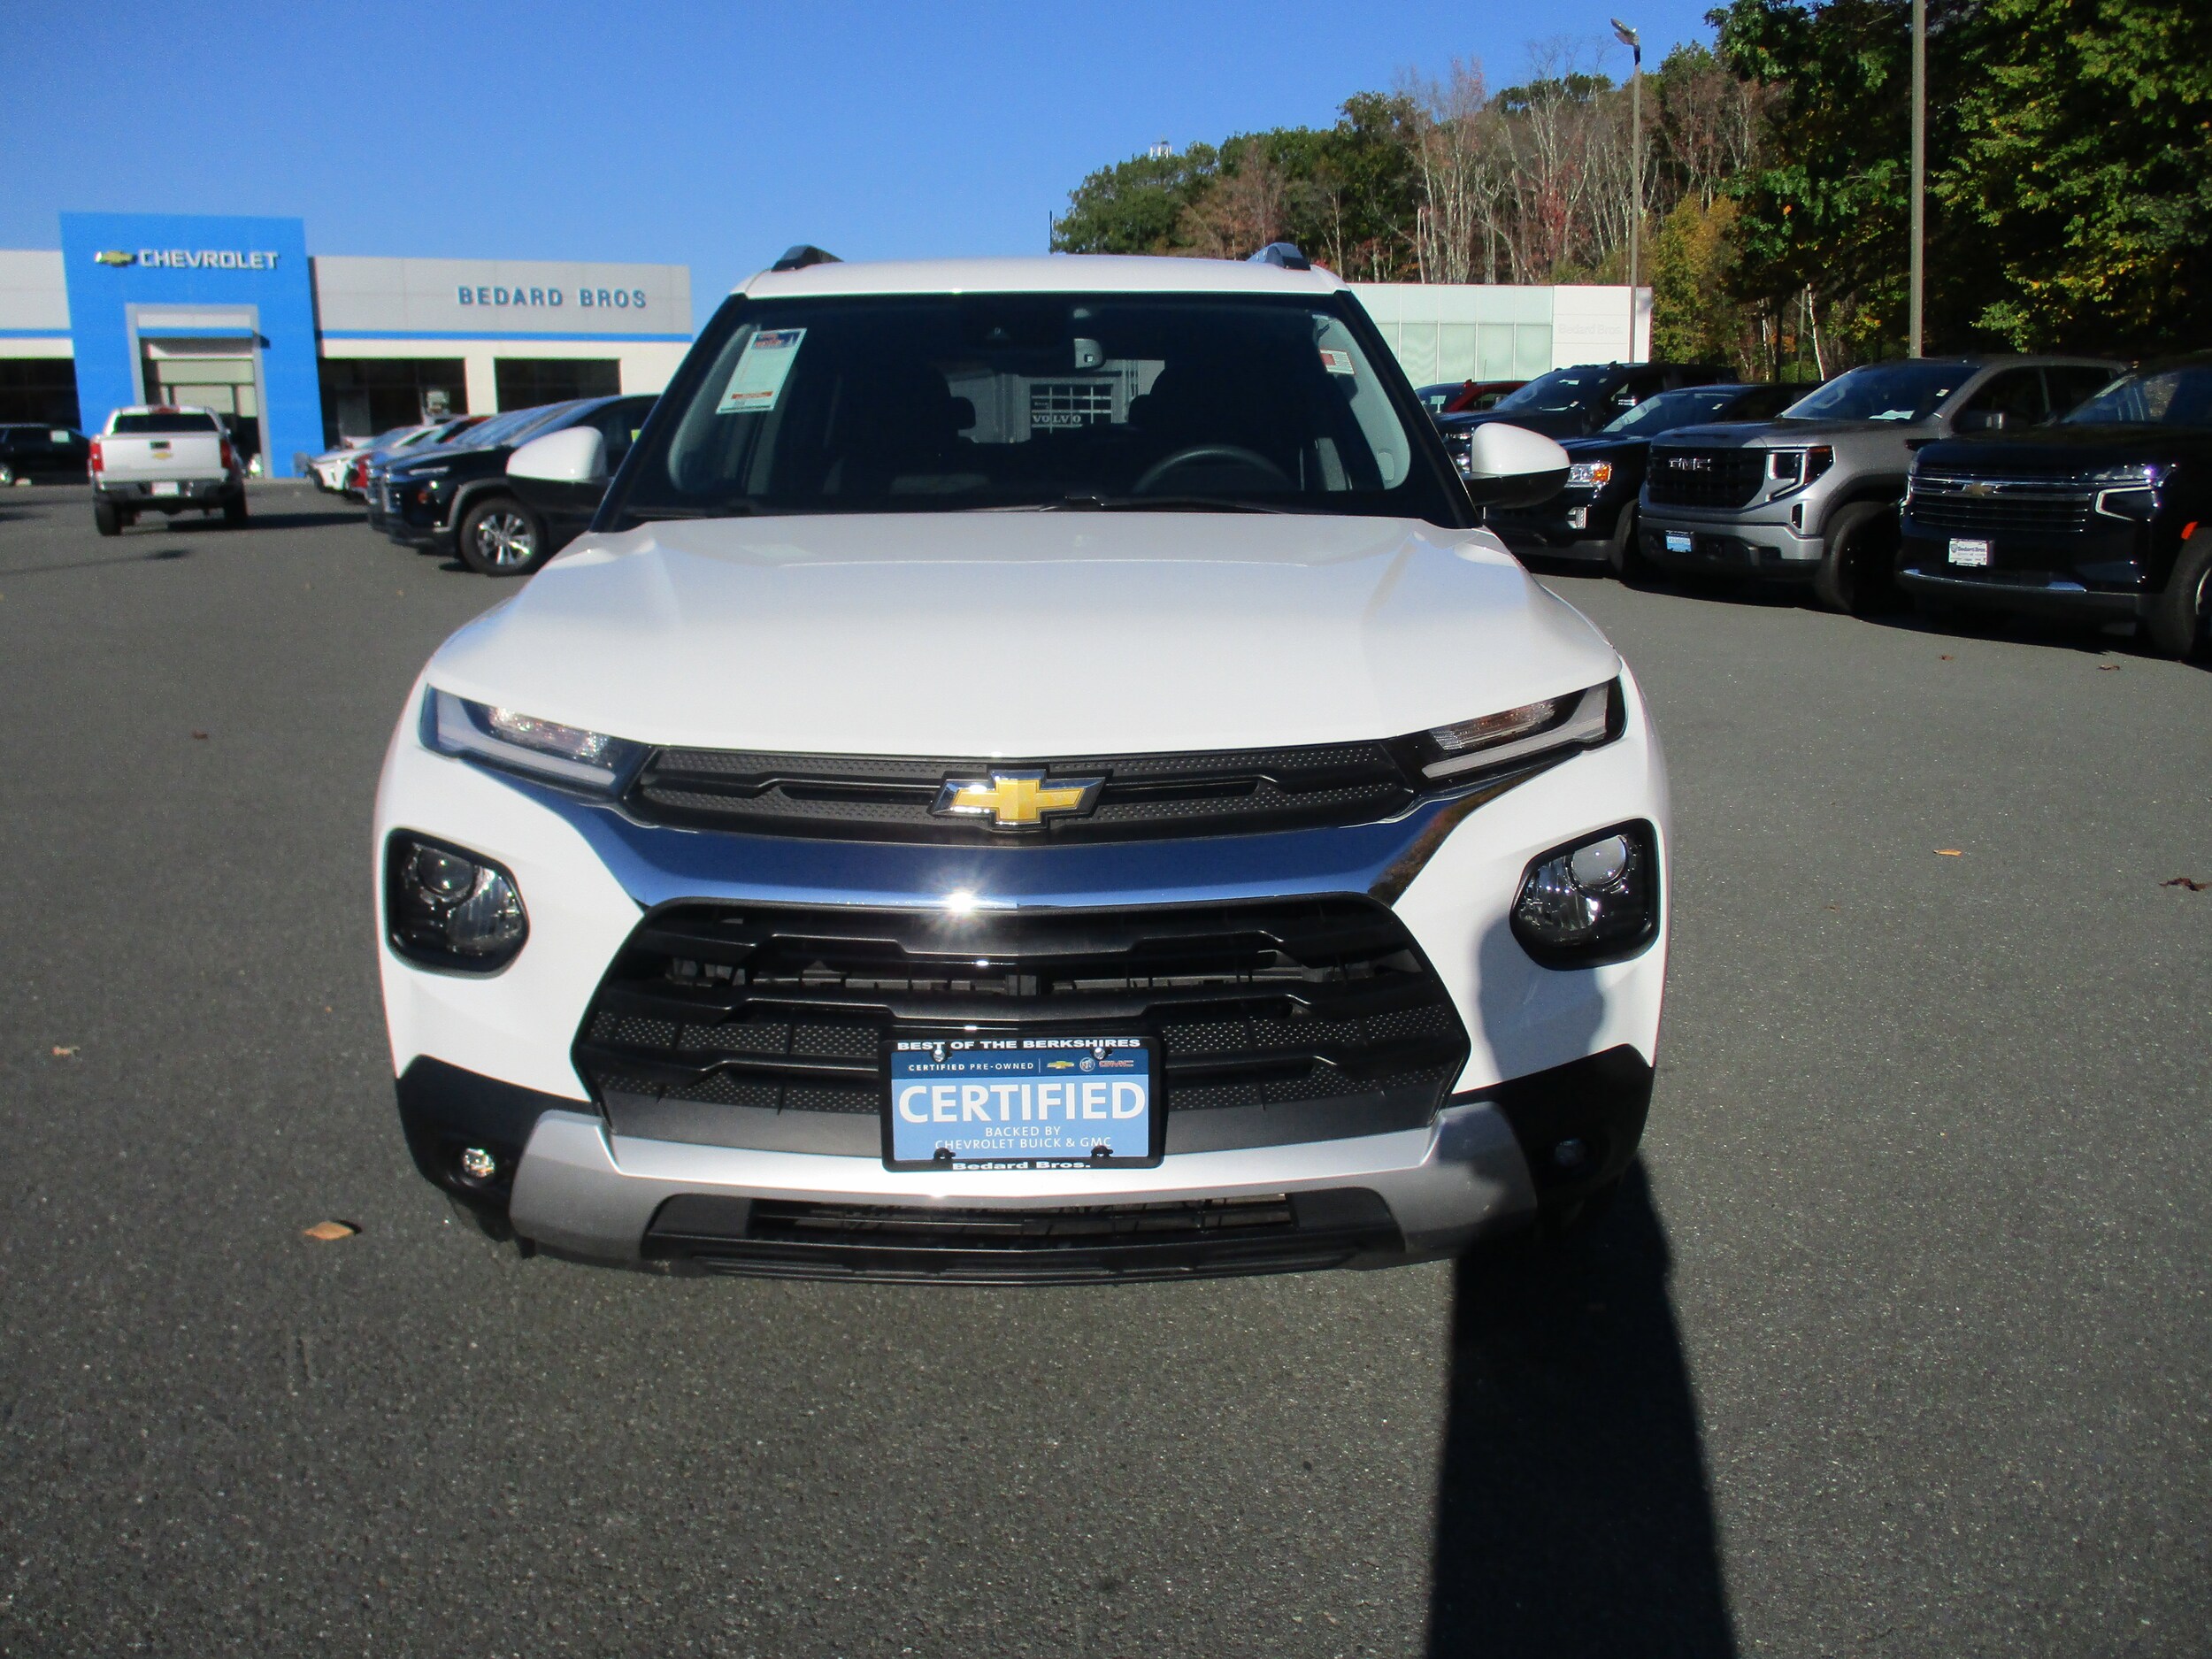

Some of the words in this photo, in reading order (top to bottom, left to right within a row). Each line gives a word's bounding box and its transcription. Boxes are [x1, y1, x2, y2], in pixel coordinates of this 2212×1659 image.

[138, 249, 279, 269] CHEVROLET
[458, 287, 564, 306] BEDARD
[579, 288, 647, 308] BROS
[1032, 414, 1081, 423] VOLVO
[897, 1041, 945, 1050] BEST
[950, 1041, 974, 1049] OF
[979, 1041, 1017, 1049] THE
[1023, 1039, 1141, 1048] BERKSHIRES
[899, 1081, 1146, 1124] CERTIFIED
[986, 1126, 1039, 1137] BACKED
[1045, 1125, 1061, 1136] BY
[934, 1139, 1013, 1150] CHEVROLET
[1020, 1138, 1061, 1148] BUICK
[1065, 1138, 1076, 1148] &
[1080, 1137, 1111, 1148] GMC
[952, 1161, 1028, 1171] Bedard
